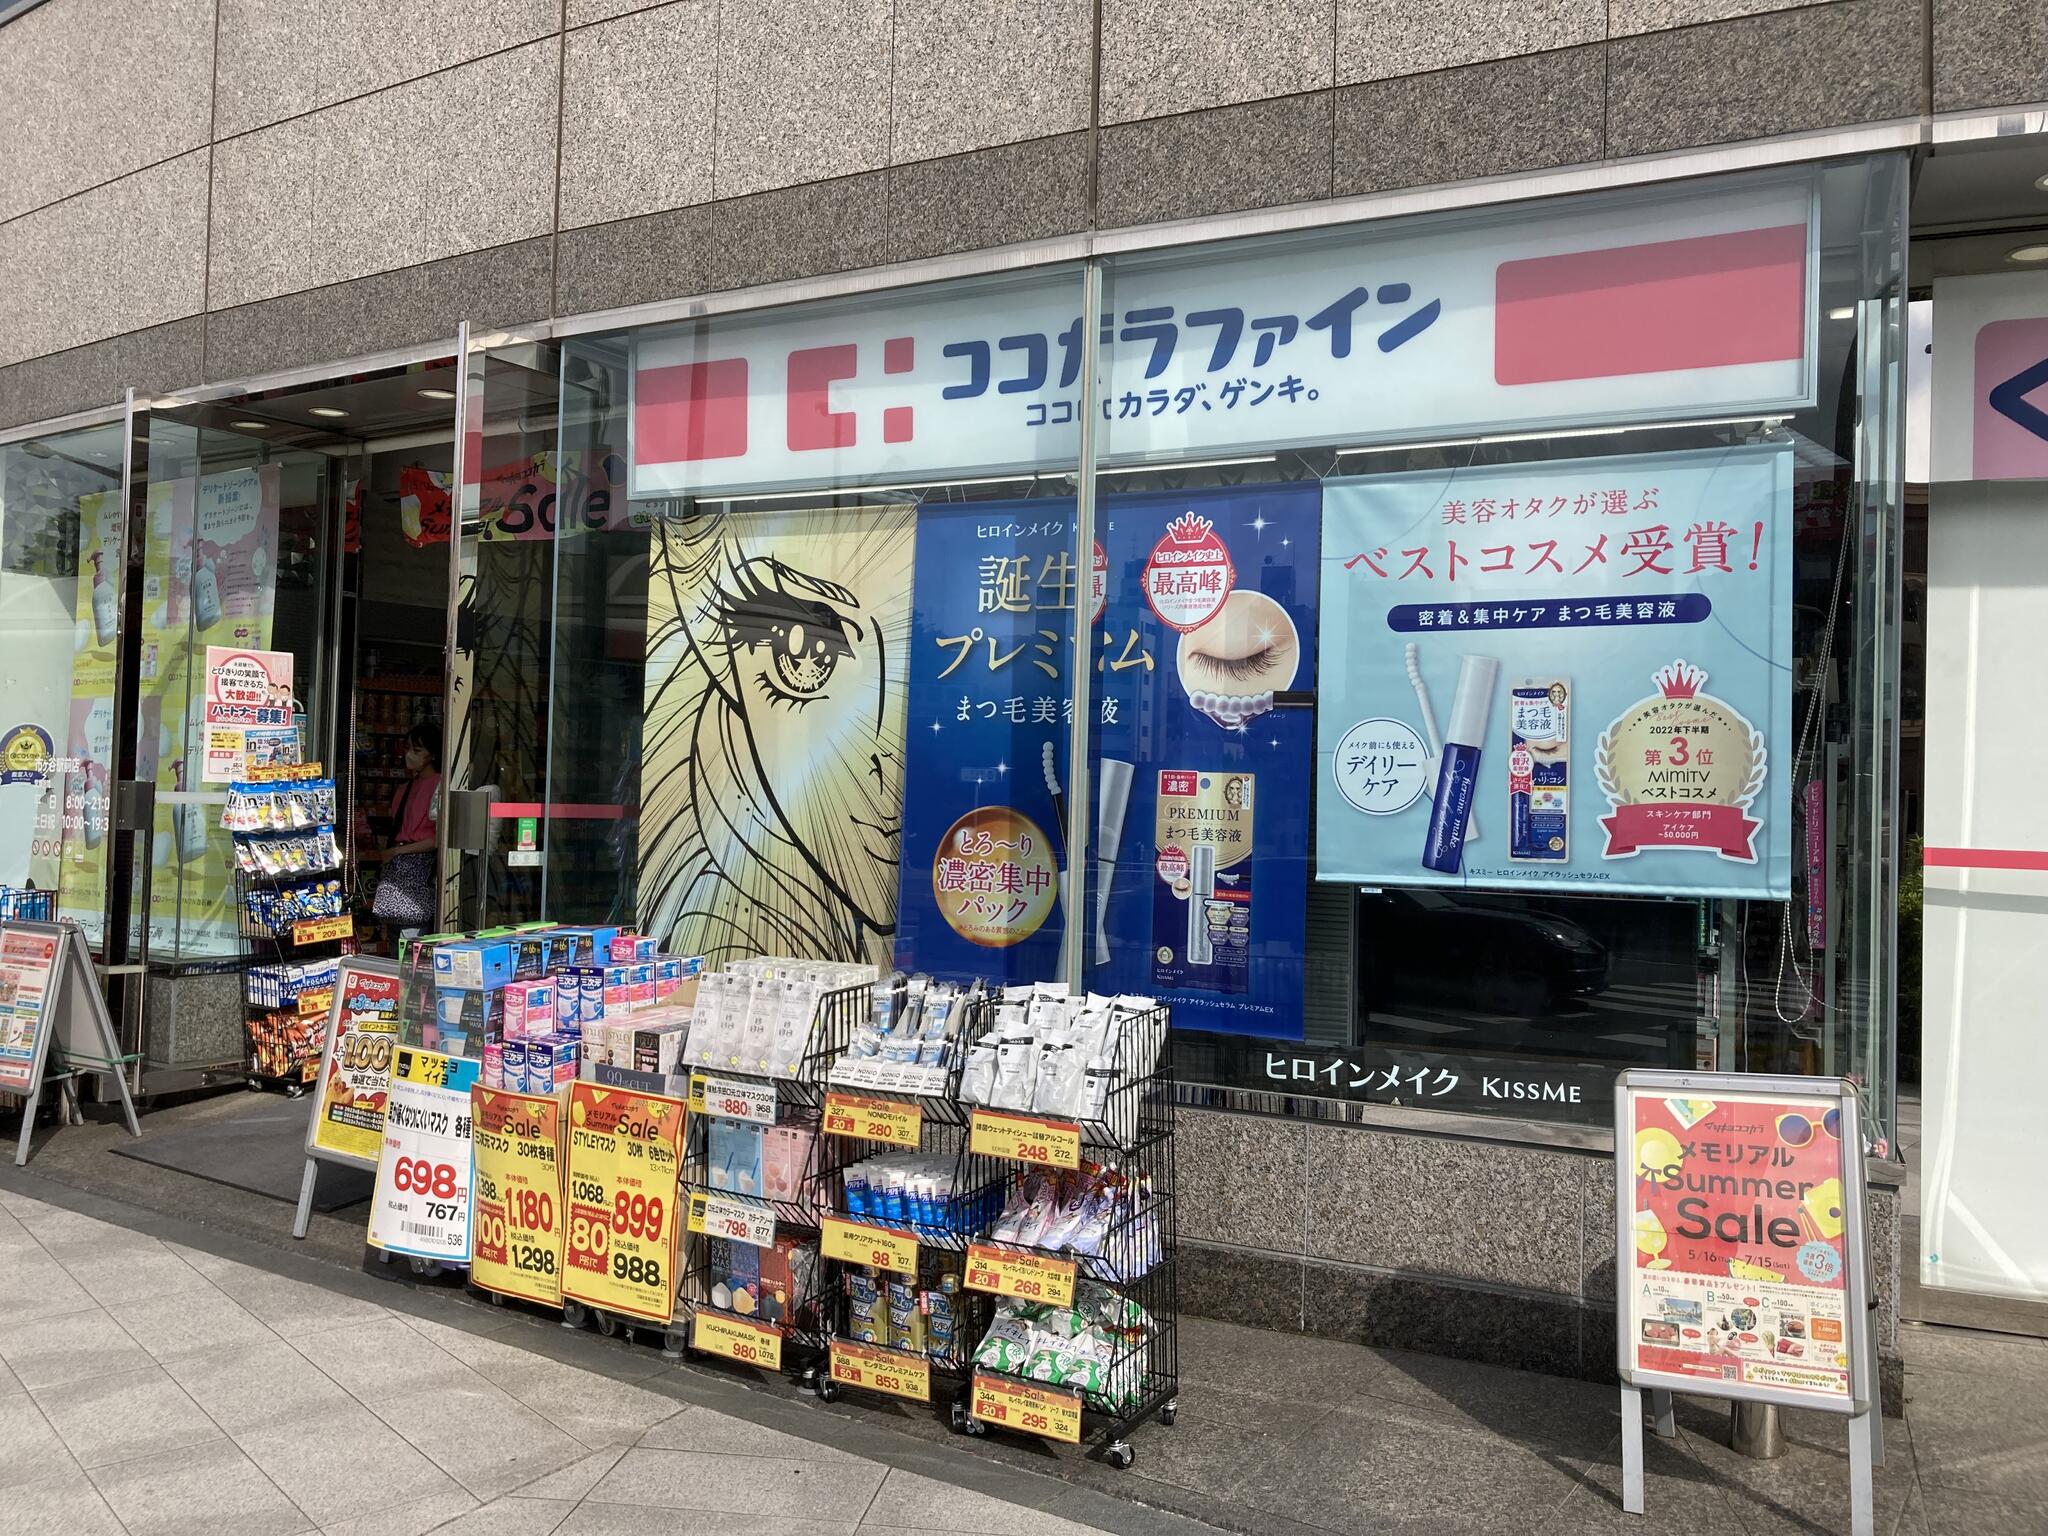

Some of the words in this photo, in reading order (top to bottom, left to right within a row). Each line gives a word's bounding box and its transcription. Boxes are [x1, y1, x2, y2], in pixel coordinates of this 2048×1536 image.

[942, 282, 1441, 400] ココカラファイン
[1026, 374, 1320, 426] ココカラダ、ゲンキ。
[1441, 487, 1660, 526] 美容オタクが選ぶ
[977, 521, 1063, 538] ヒロインメイク
[1155, 549, 1224, 564] ヒロインメイク史上
[1343, 519, 1765, 582] ベストコスメ受賞！
[978, 551, 1077, 614] 誕生
[1153, 569, 1222, 595] 最高峰
[1558, 601, 1677, 623] まつ毛美容液
[935, 627, 1156, 680] プレミム
[211, 667, 266, 679] とびきりの笑顔で
[1517, 706, 1552, 718] まつ毛
[1643, 702, 1719, 720] 美容オタクが選んだ
[1516, 718, 1552, 730] 美容液
[1649, 725, 1710, 735] 2022年下半期
[1348, 741, 1416, 750] メイク前にも使える
[1346, 756, 1417, 776] デイリー
[1167, 780, 1189, 793] 濃密
[1362, 779, 1400, 797] ケア
[1641, 786, 1718, 799] ベストコスメ
[1169, 808, 1240, 822] PREMIUM
[1646, 809, 1712, 820] スキンケア部門
[1166, 825, 1242, 843] まつ毛美容液
[1662, 823, 1695, 831] アイケア
[938, 857, 1052, 897] 濃密集中
[1469, 868, 1493, 876] キスミー
[1496, 869, 1539, 878] ヒロインメイク
[1542, 870, 1611, 880] アイラッシュセラムEX
[958, 897, 1030, 923] パック
[322, 930, 337, 939] 209
[420, 1055, 458, 1073] マツキヨ
[857, 1068, 878, 1076] NONIO
[424, 1071, 449, 1086] イイヨ
[1265, 1052, 1460, 1097] ヒロインメイク
[725, 1099, 748, 1116] 880
[755, 1103, 771, 1114] 968
[830, 1107, 845, 1116] 327
[867, 1110, 908, 1123] NONIOモバイル
[871, 1101, 890, 1112] Sale
[455, 1115, 472, 1139] 各種
[503, 1115, 541, 1139] Sale
[586, 1118, 616, 1132] Summer
[587, 1110, 617, 1122] メモリアル
[617, 1113, 659, 1141] Sale
[832, 1119, 845, 1130] 20
[867, 1122, 892, 1138] 280
[474, 1130, 510, 1154] 三次元マスク
[517, 1142, 555, 1163] 30枚各種
[573, 1131, 616, 1154] STYLEYマスク
[627, 1141, 644, 1158] 30枚
[1017, 1143, 1048, 1162] 248
[1054, 1149, 1070, 1159] 272
[1677, 1141, 1795, 1168] メモリアル
[1662, 1163, 1814, 1201] Summer
[571, 1180, 604, 1205] 1,068
[725, 1218, 747, 1238] 798
[755, 1226, 770, 1237] 877
[1675, 1197, 1800, 1249] Sale
[447, 1233, 463, 1246] 536
[571, 1217, 609, 1256] 80
[872, 1250, 890, 1266] 98
[897, 1256, 910, 1266] 107
[974, 1261, 987, 1271] 314
[1019, 1255, 1040, 1268] Sale
[975, 1274, 988, 1285] 20
[1013, 1279, 1041, 1296] 268
[1047, 1287, 1061, 1297] 294
[706, 1323, 756, 1343] KUCHIRAKUMASK
[732, 1342, 757, 1361] 980
[876, 1353, 895, 1365] Sale
[864, 1360, 925, 1379] モンダミンプレミアムケア
[839, 1368, 852, 1379] 50
[875, 1374, 900, 1390] 853
[979, 1391, 995, 1402] 344
[1023, 1388, 1046, 1402] Sale
[982, 1405, 996, 1416] 20
[1021, 1411, 1048, 1430] 295
[1054, 1422, 1068, 1432] 324
